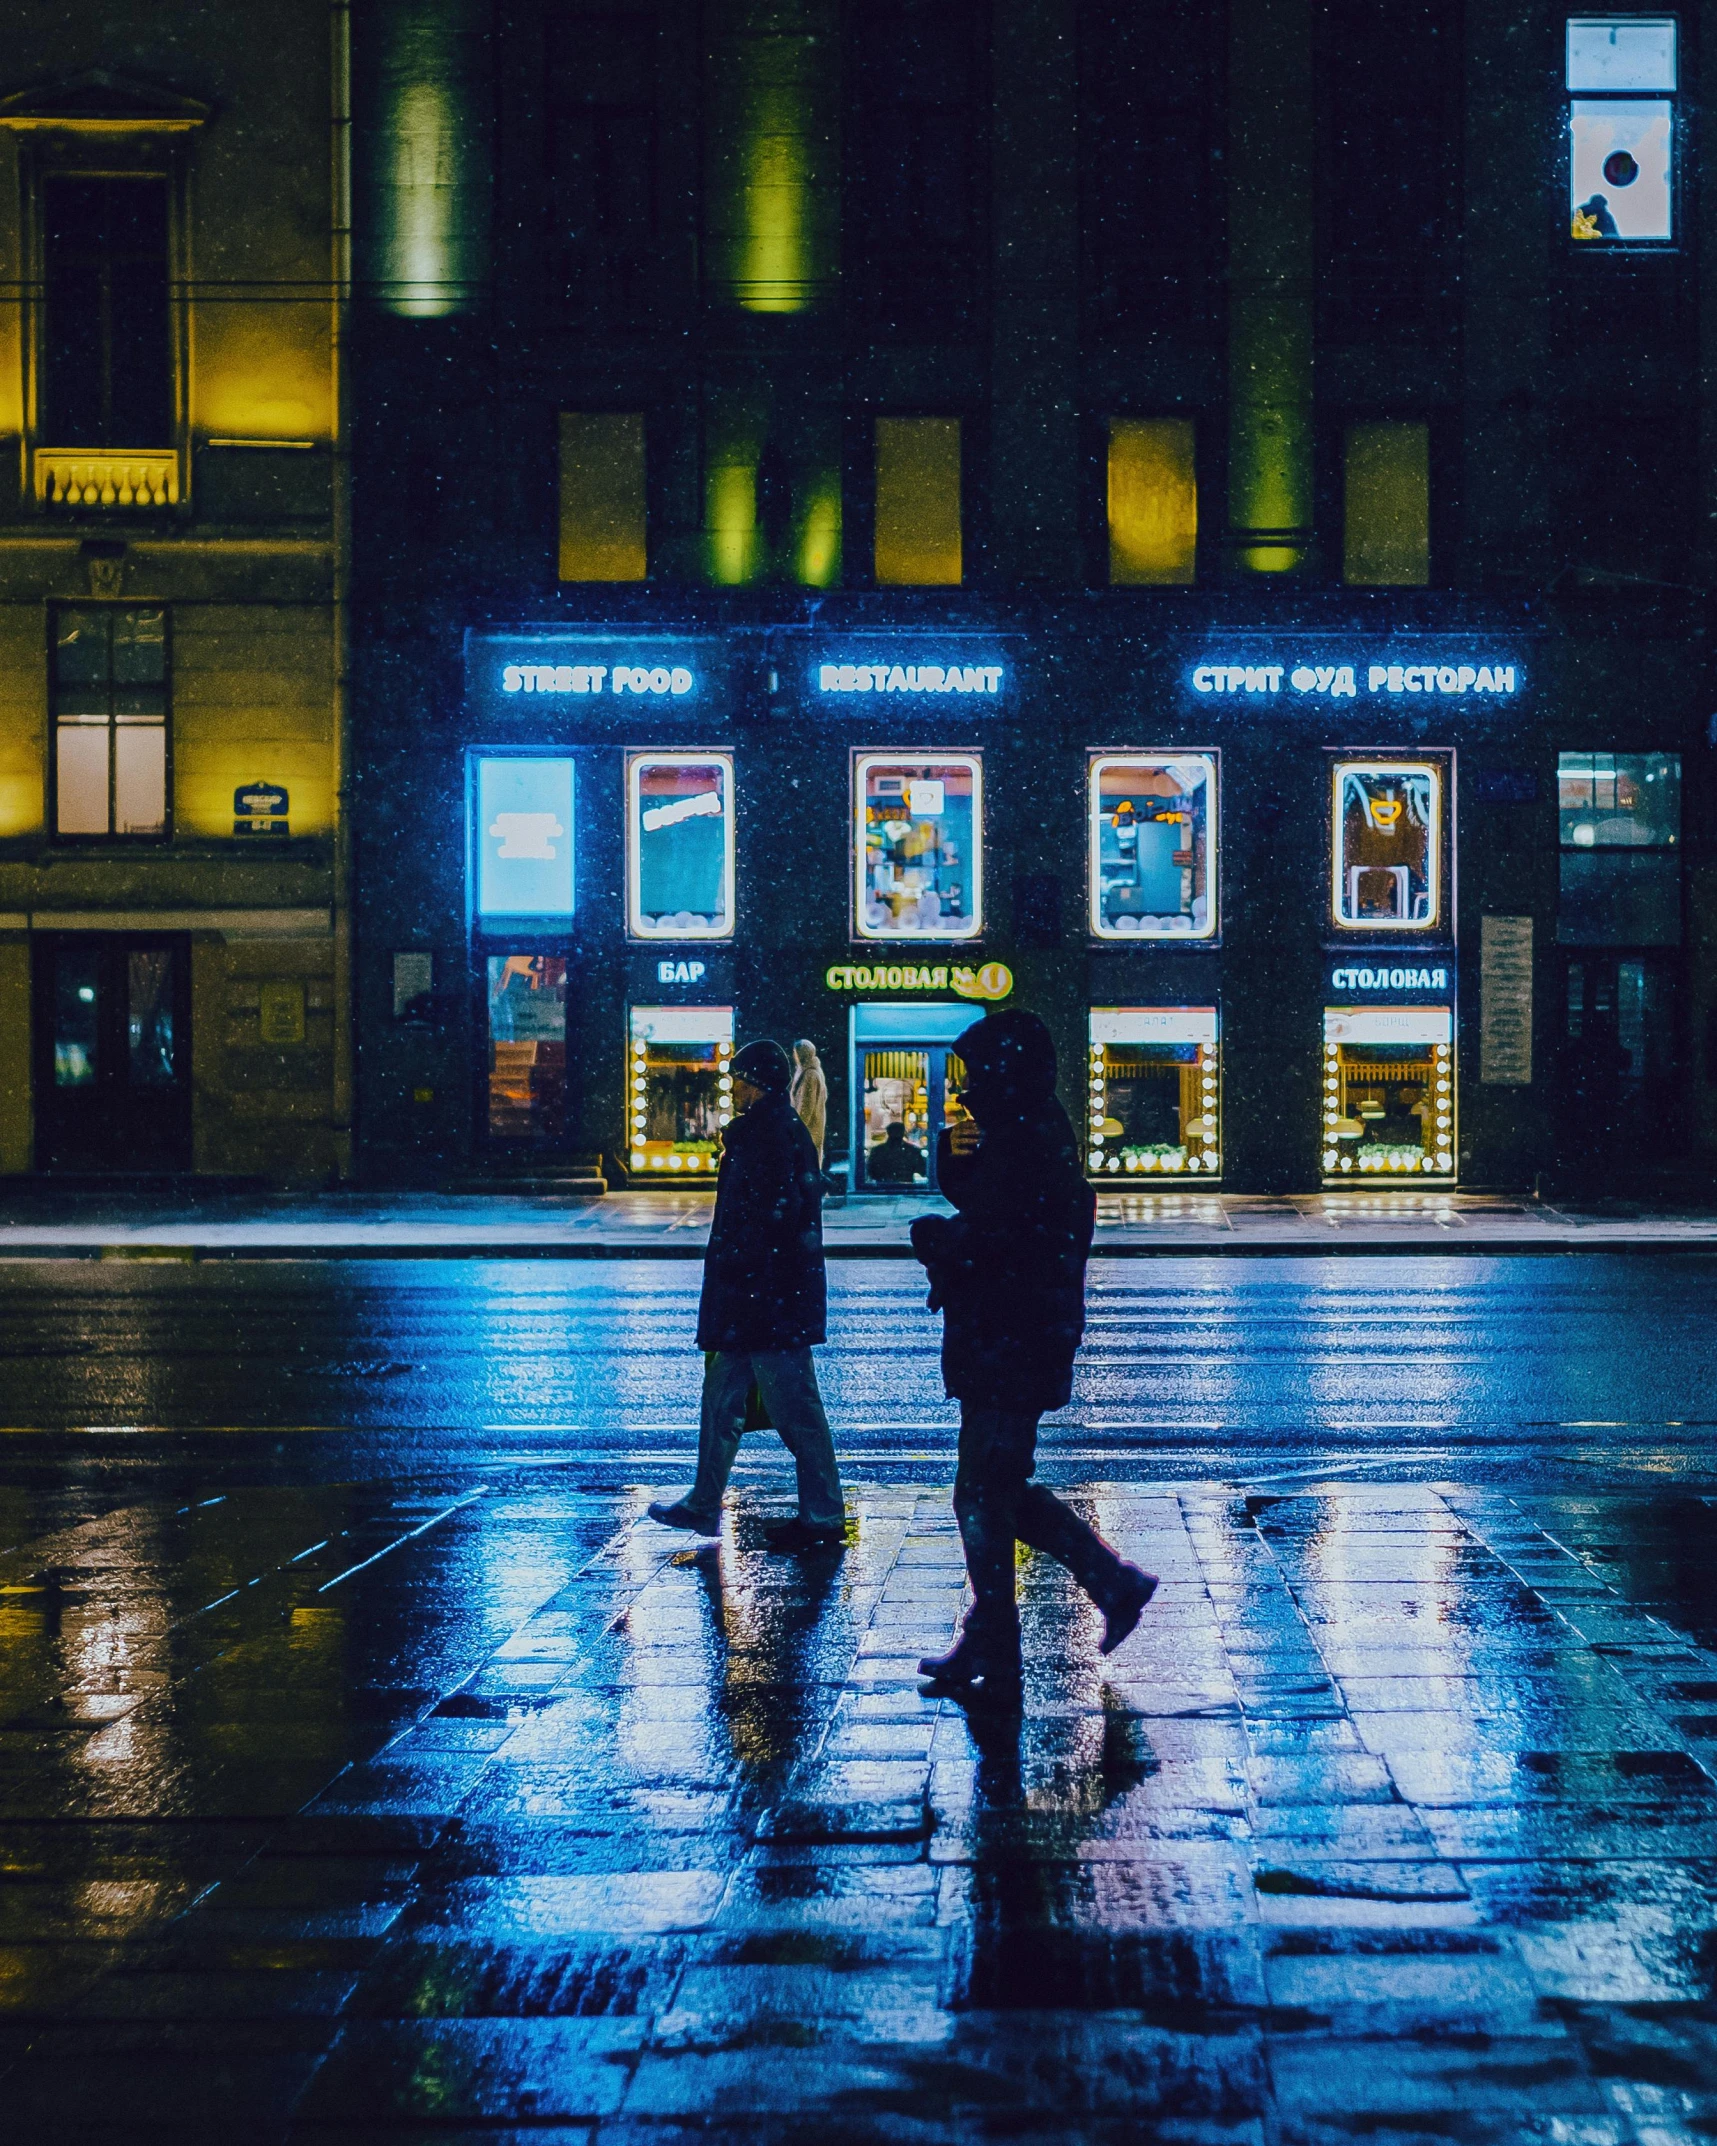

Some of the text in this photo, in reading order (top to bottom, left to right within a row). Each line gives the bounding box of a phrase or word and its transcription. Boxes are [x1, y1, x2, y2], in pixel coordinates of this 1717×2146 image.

[502, 664, 694, 696] STREET FOOD
[819, 664, 1004, 694] RESTAURANT
[1191, 664, 1516, 698] СТРИТ ФУД РЕСТОРАН
[658, 960, 706, 983] БАР
[826, 966, 949, 990] СТОЛОВАЯ
[1331, 967, 1447, 989] СТОЛОВАЯ
